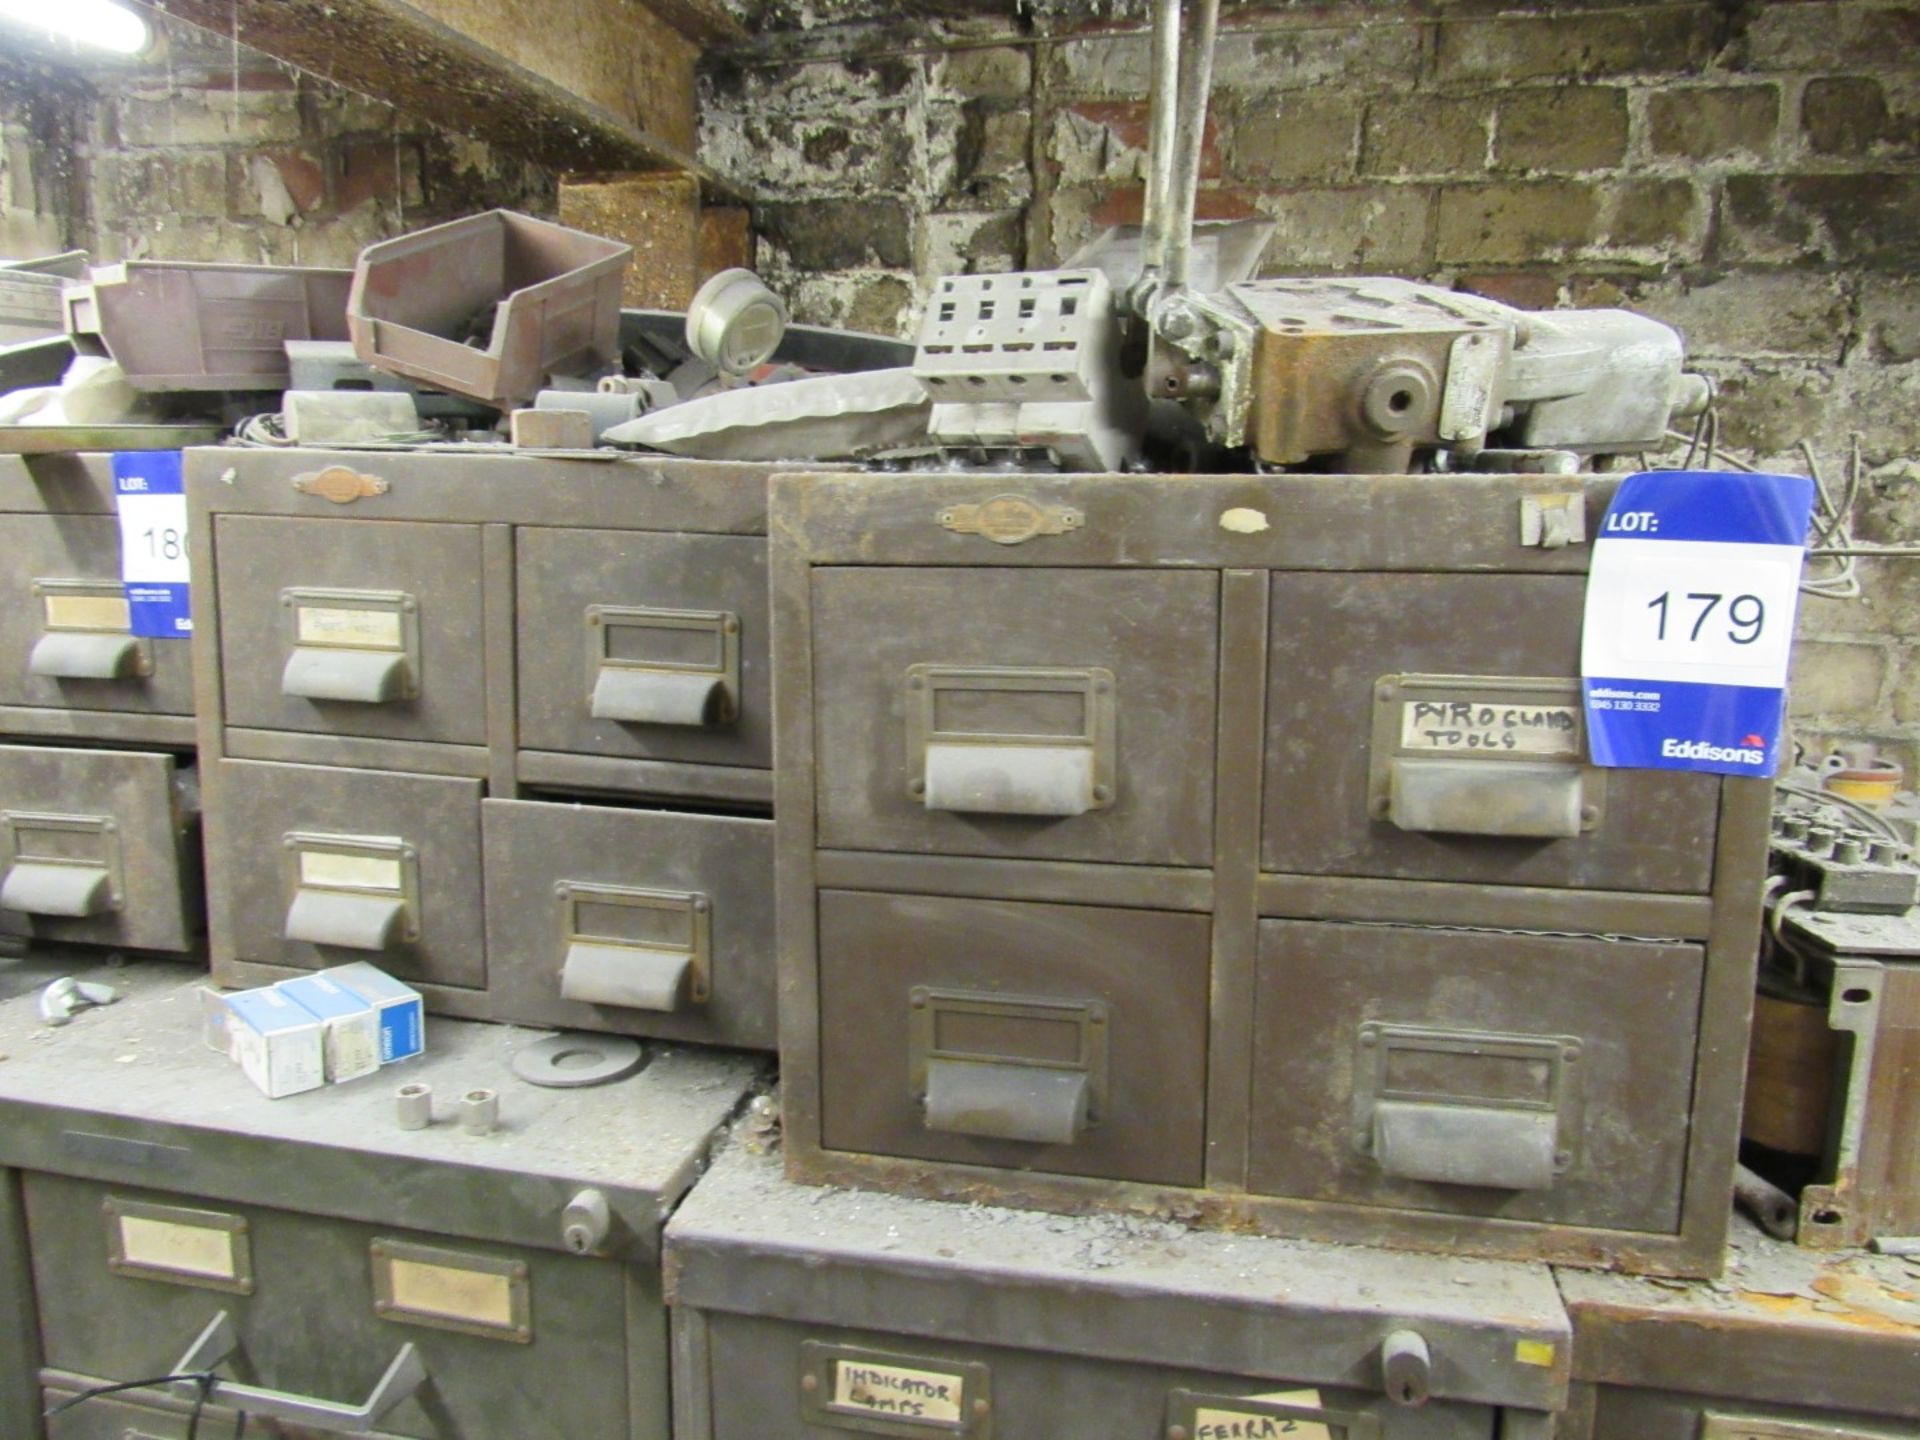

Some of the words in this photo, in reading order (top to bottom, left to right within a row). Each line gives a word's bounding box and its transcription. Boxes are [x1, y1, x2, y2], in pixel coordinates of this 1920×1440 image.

[1607, 512, 1660, 532] LOT:
[143, 527, 190, 561] 18
[1647, 591, 1766, 645] 179
[1414, 702, 1496, 727] PYRO
[1662, 739, 1764, 764] Eddisons
